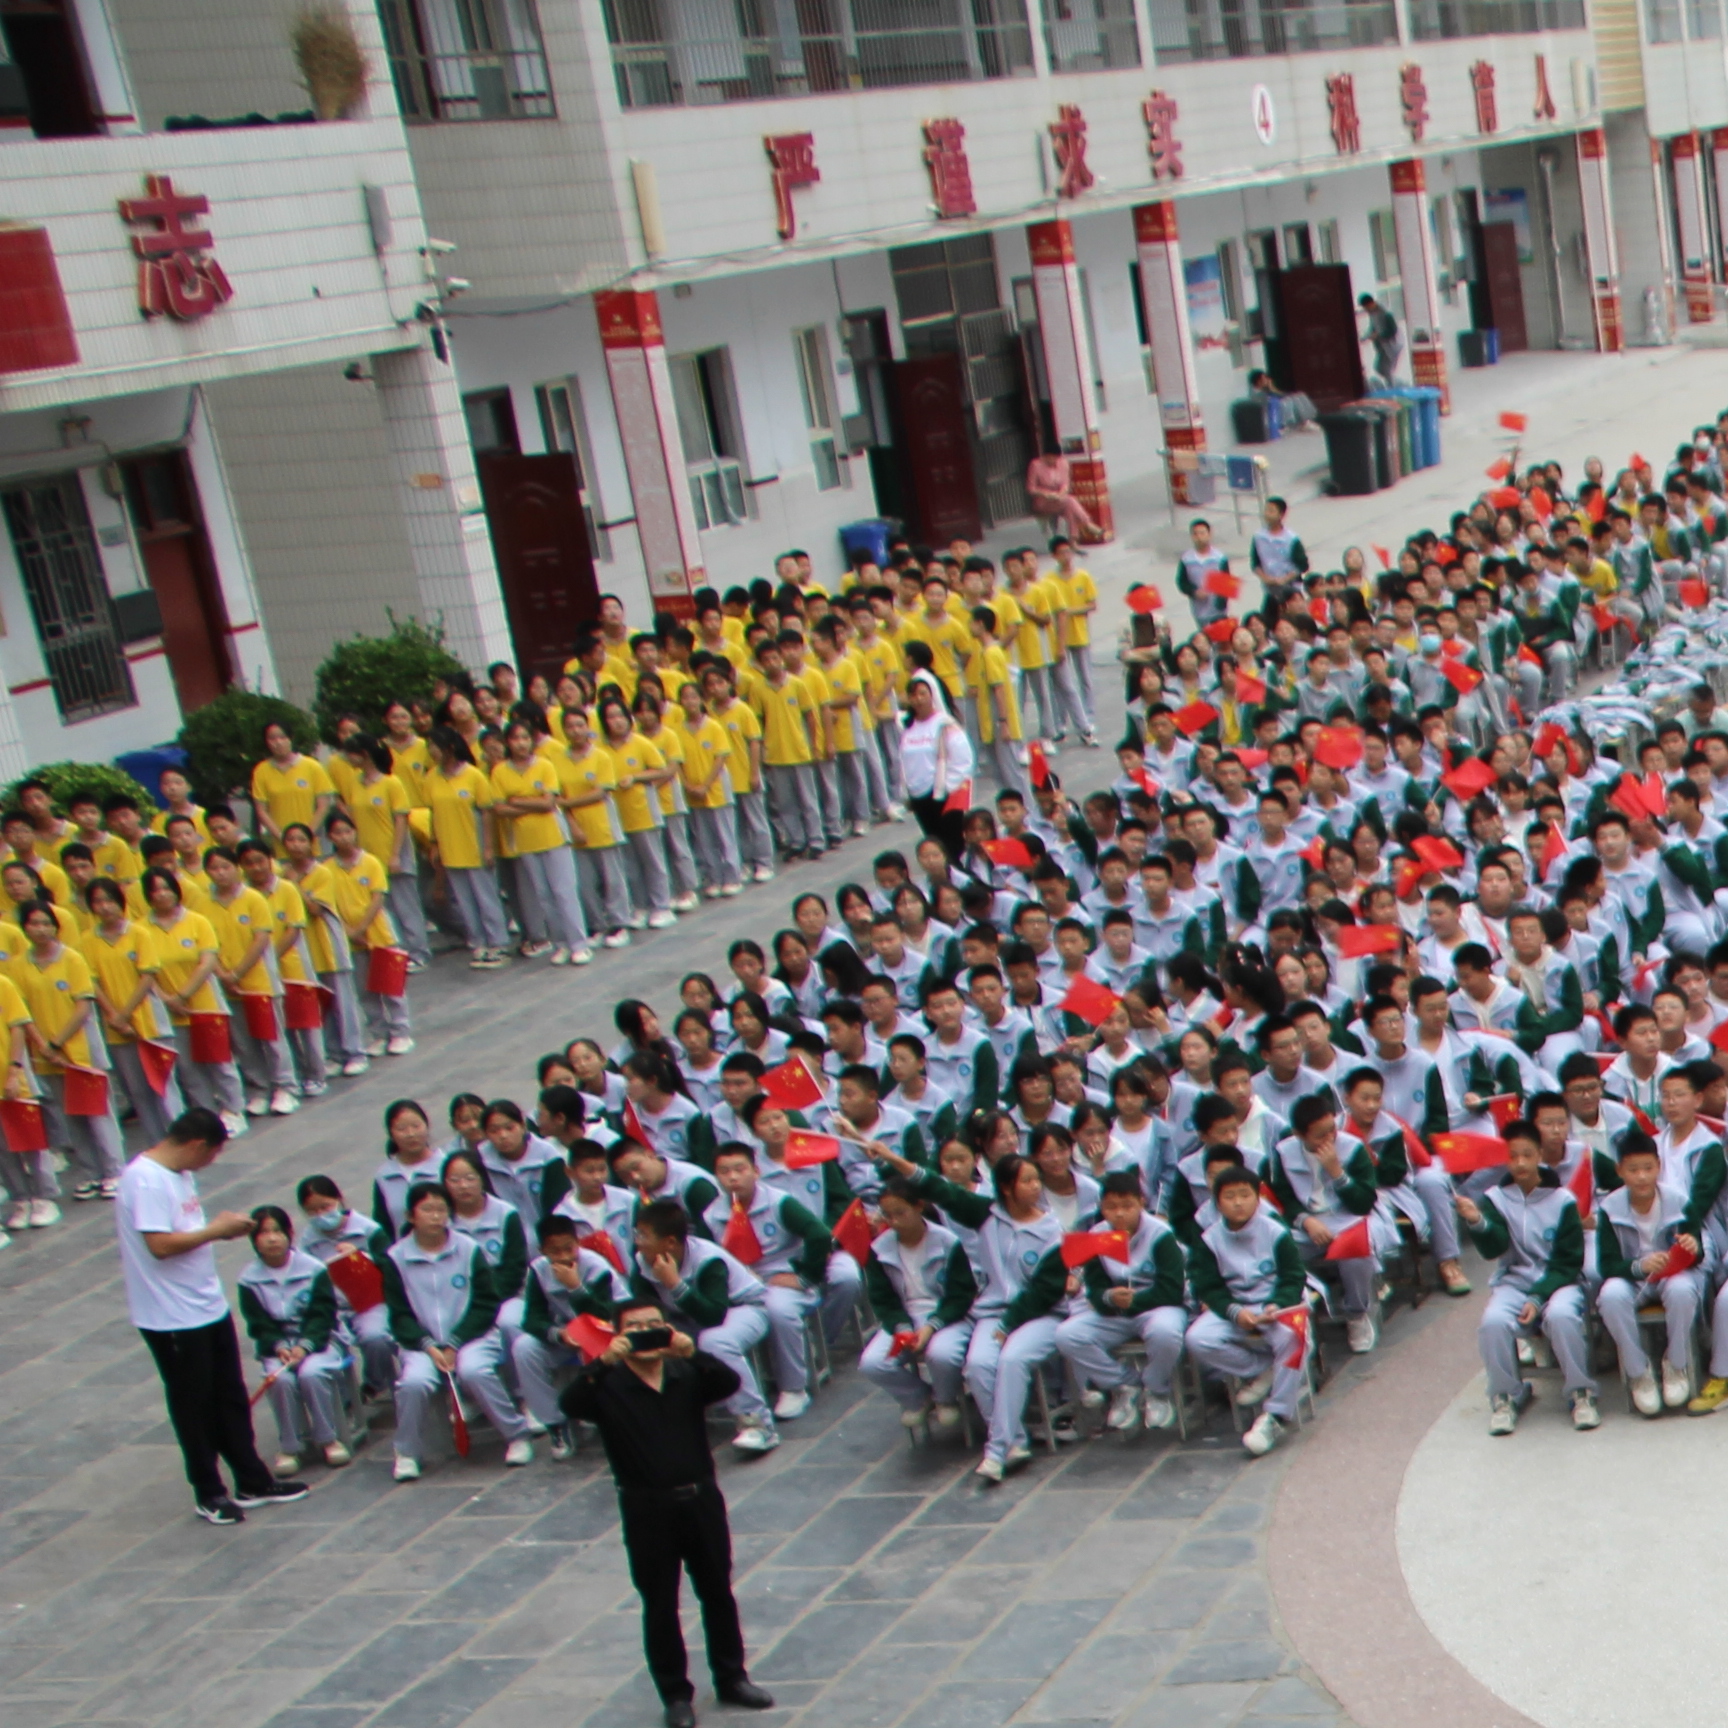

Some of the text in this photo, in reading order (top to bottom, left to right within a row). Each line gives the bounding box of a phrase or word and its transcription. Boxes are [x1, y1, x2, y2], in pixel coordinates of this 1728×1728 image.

[763, 90, 1185, 239] 严谨求实
[1326, 53, 1556, 154] 科学育人
[117, 173, 234, 322] 志
